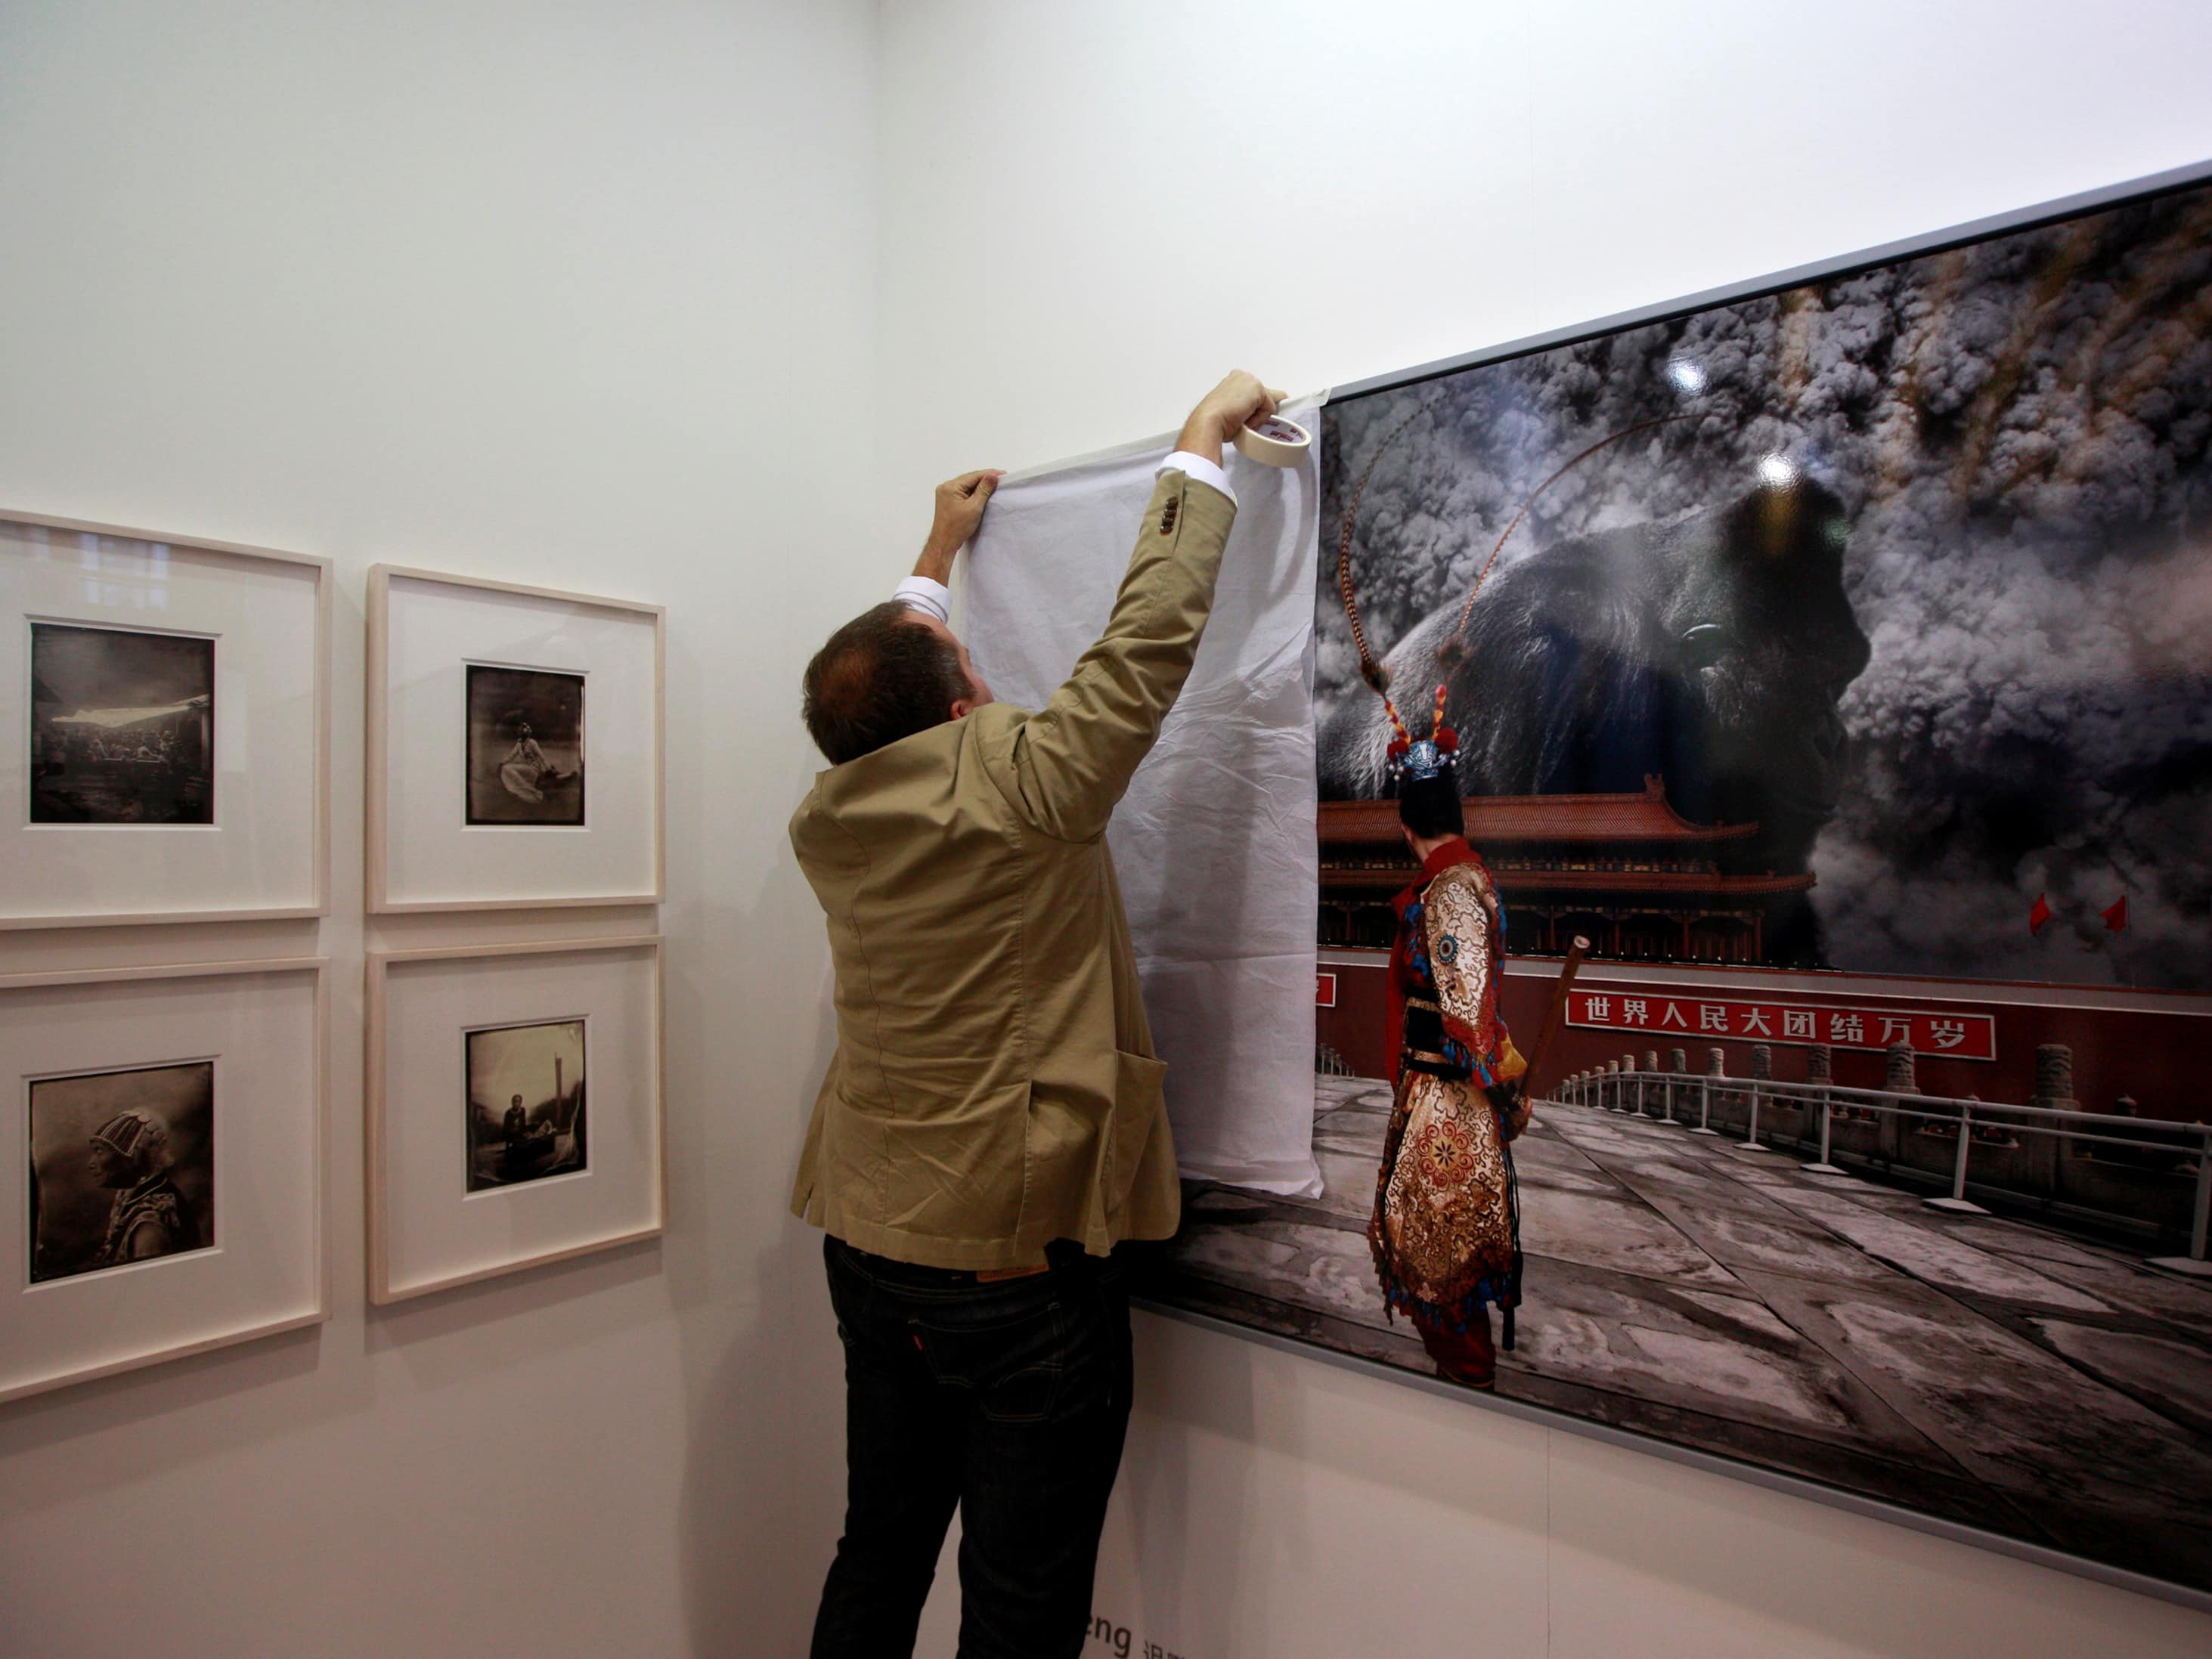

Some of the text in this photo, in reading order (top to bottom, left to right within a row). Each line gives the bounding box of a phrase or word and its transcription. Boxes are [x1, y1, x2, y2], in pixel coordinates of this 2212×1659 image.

[1585, 997, 1966, 1049] 世界人民大团结万岁
